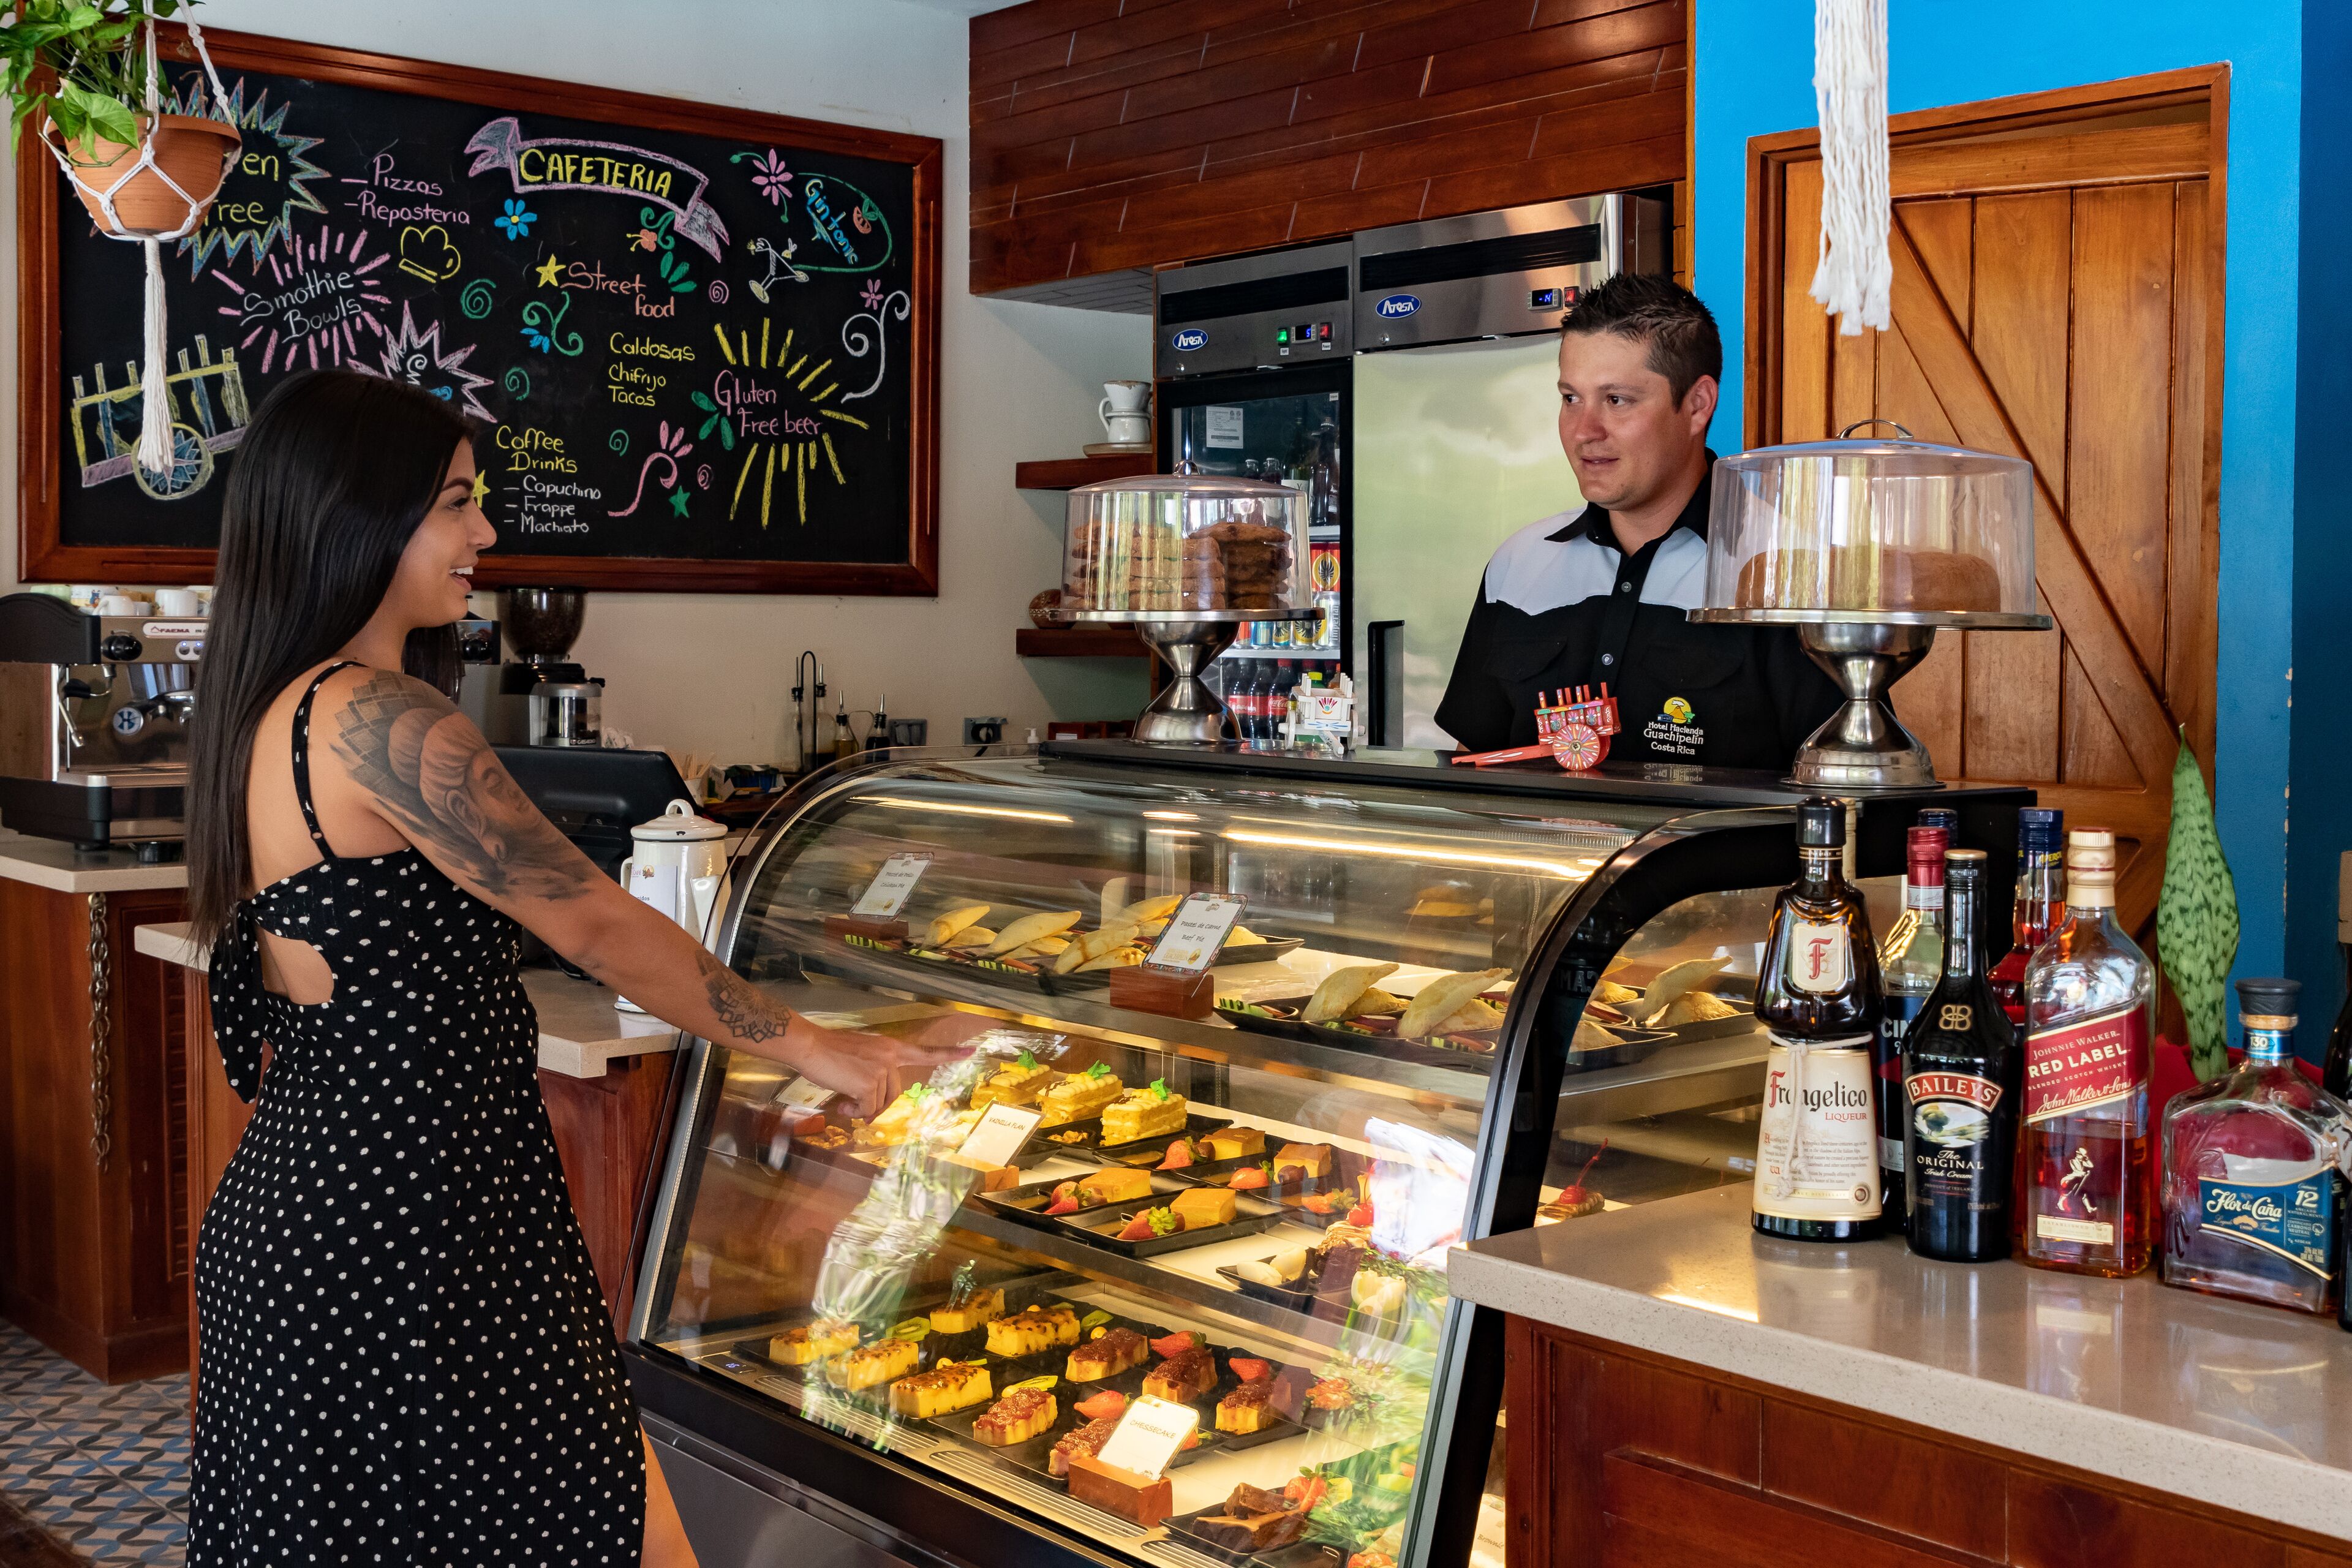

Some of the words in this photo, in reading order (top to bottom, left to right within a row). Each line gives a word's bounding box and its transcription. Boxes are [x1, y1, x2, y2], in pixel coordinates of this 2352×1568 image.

[373, 153, 443, 196] Pizzas
[519, 148, 672, 197] CAFETERIA
[358, 190, 470, 227] Reposteria
[805, 178, 830, 221] Gin
[560, 260, 647, 294] Street
[239, 271, 355, 326] Smothie
[281, 296, 362, 343] Bowls
[610, 332, 695, 361] Caldosas
[608, 379, 656, 407] Tacos
[714, 369, 777, 417] Gluten
[737, 407, 779, 437] Free
[785, 409, 823, 435] beer
[496, 425, 565, 453] Coffee
[505, 451, 578, 473] Drinks
[523, 475, 601, 500] Capuchino
[524, 496, 576, 518] Frappe
[521, 512, 590, 533] Machiato
[1643, 728, 1704, 745] Guachipelín
[1648, 722, 1668, 731] Hotel
[1670, 723, 1703, 736] Hacienda
[1651, 741, 1675, 753] Costa
[1677, 745, 1695, 755] Rica
[1181, 934, 1195, 943] Beef
[2033, 1041, 2075, 1061] JOHNNIE
[2075, 1030, 2117, 1047] WALKER
[2027, 1059, 2064, 1079] RED
[2067, 1042, 2128, 1068] LABEL
[2027, 1079, 2061, 1091] BLENDED
[2064, 1070, 2094, 1082] SCOTCH
[2097, 1060, 2127, 1073] WHISKY
[1910, 1077, 1994, 1102] BAILEYS
[2064, 1084, 2104, 1104] Walker
[1011, 1122, 1026, 1131] FLAN
[1825, 1112, 1868, 1123] LIQUEUR
[1917, 1155, 1985, 1170] ORIGINAL
[1937, 1150, 1961, 1159] The
[1924, 1168, 1945, 1177] Irish
[2206, 1189, 2242, 1213] Flor
[2242, 1200, 2253, 1211] de
[2251, 1196, 2283, 1223] Caña
[2294, 1190, 2320, 1208] 12
[1129, 1419, 1177, 1439] CHESSECAKE
